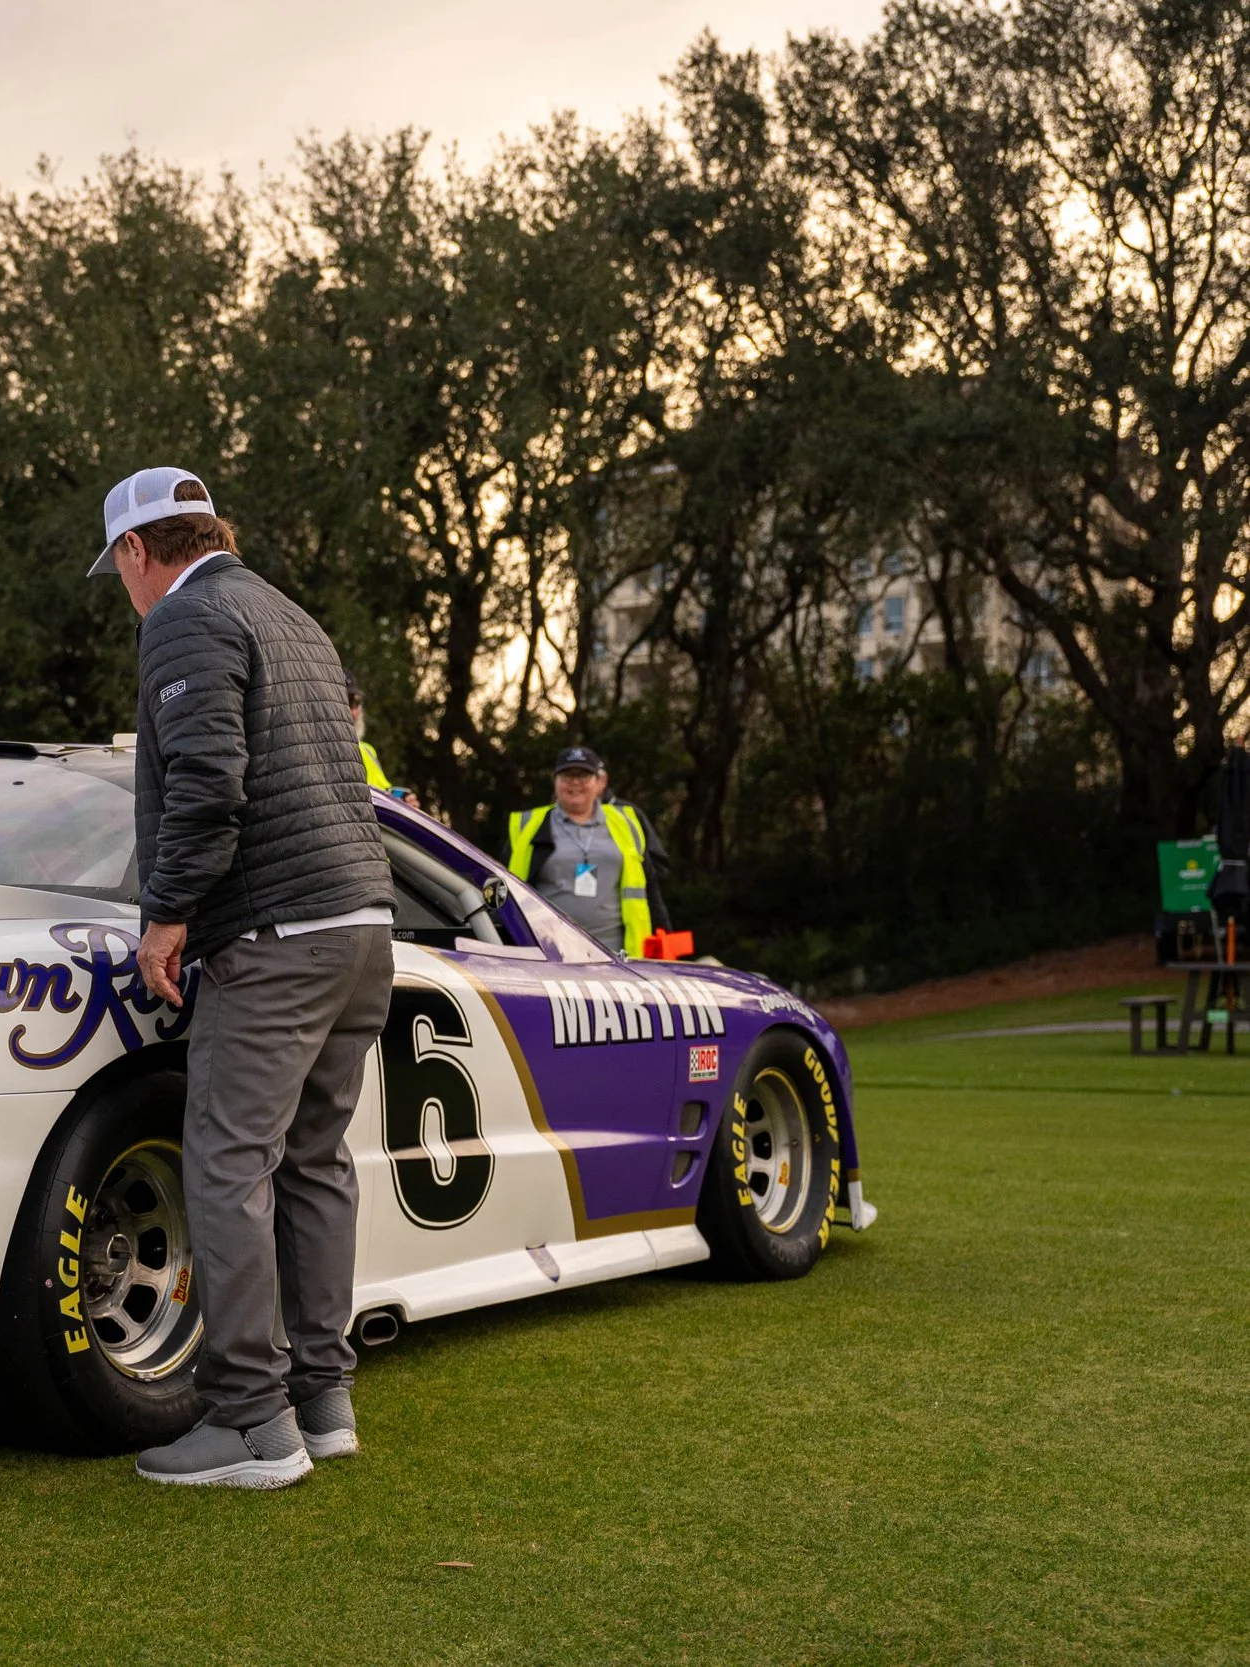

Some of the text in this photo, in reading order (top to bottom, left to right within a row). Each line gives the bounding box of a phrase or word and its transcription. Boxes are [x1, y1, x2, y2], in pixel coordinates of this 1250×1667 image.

[541, 979, 726, 1048] MARTIN
[698, 1050, 717, 1071] IROC
[377, 972, 495, 1230] 6
[732, 1092, 753, 1206] EAGLE
[58, 1185, 91, 1355] EAGLE
